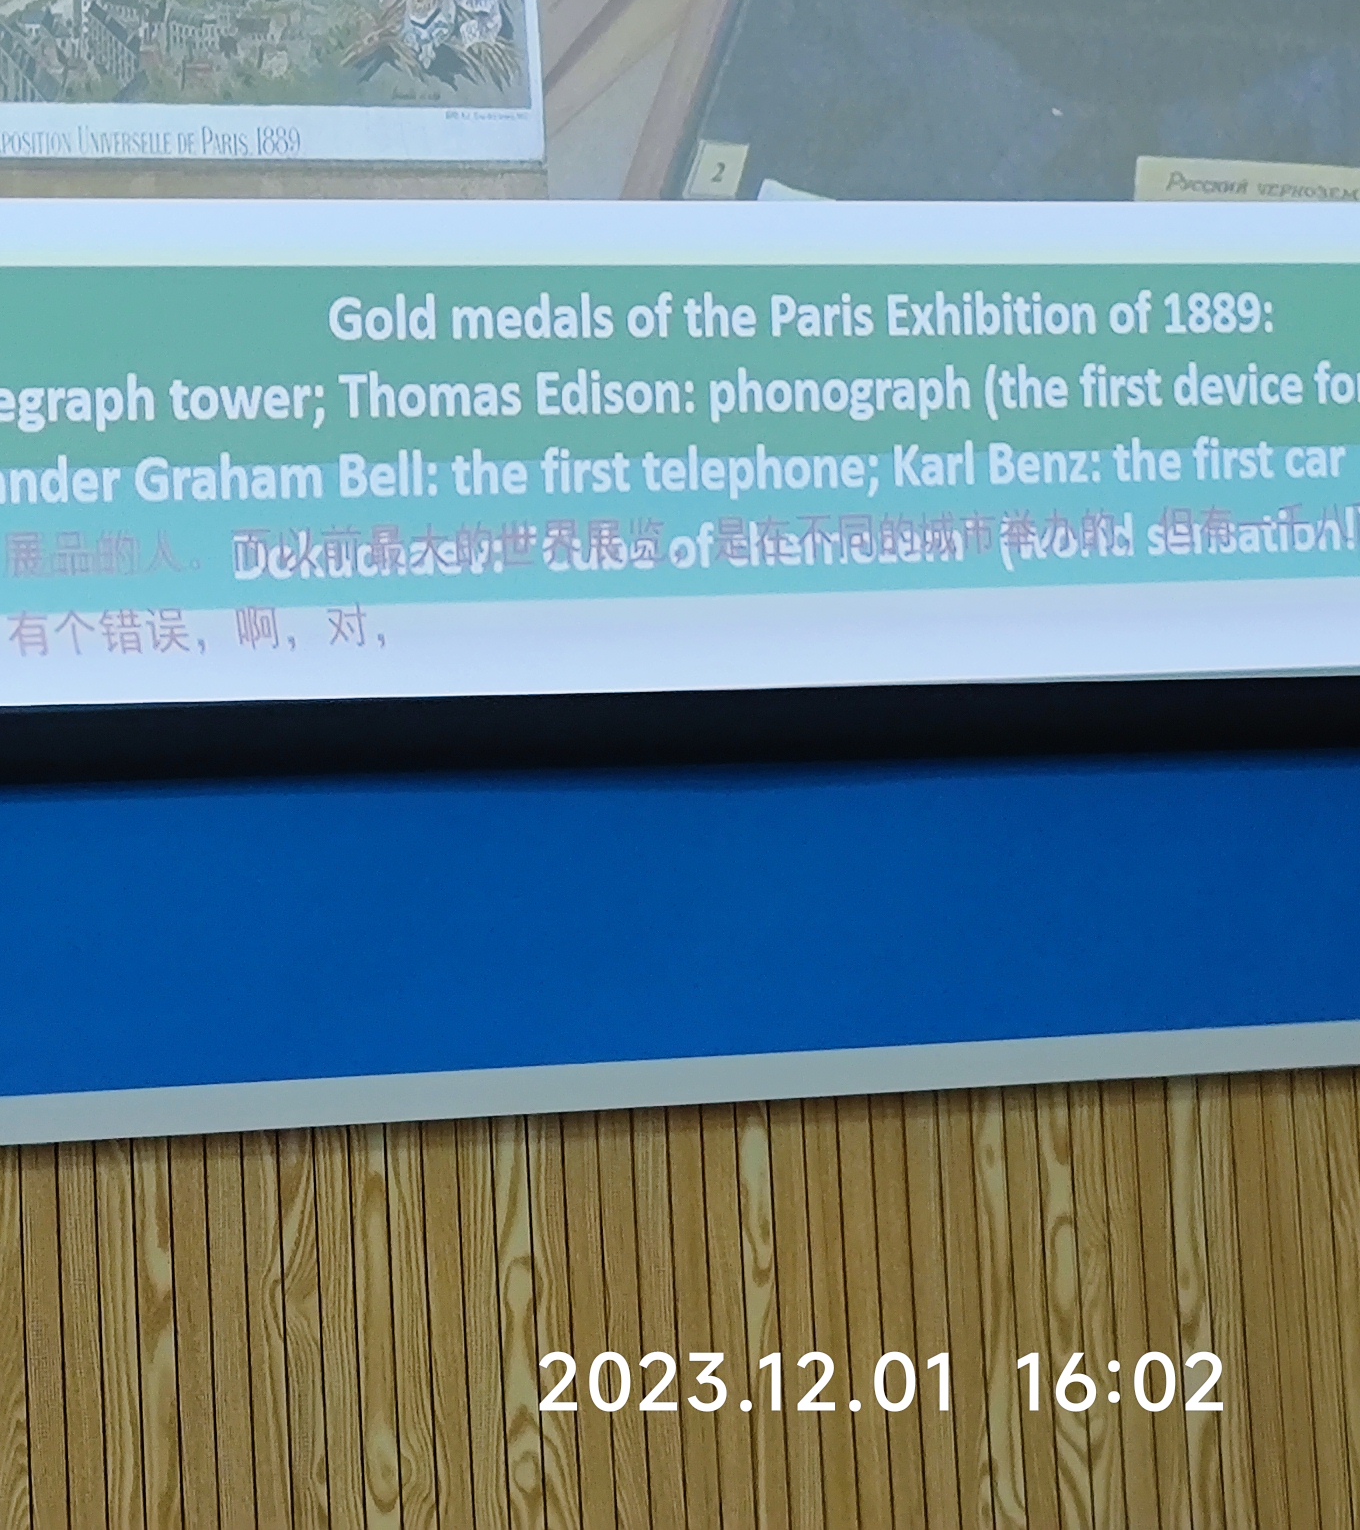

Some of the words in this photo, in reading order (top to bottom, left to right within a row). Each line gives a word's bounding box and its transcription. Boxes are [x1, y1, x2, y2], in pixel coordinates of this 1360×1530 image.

[256, 125, 302, 157] 1889
[710, 161, 726, 183] 2
[328, 294, 436, 342] Gold
[452, 293, 614, 340] medals
[627, 292, 672, 339] of
[684, 290, 757, 338] the
[770, 290, 874, 338] Paris
[886, 290, 1097, 337] Exhibition
[1108, 291, 1151, 335] of
[1164, 292, 1274, 334] 1889:
[170, 378, 326, 430] tower;
[339, 371, 522, 421] Thomas
[536, 369, 695, 418] Edison:
[709, 366, 970, 423] phonograph
[983, 364, 1068, 420] (the
[1080, 363, 1162, 410] first
[1174, 360, 1303, 407] device
[135, 454, 323, 503] Graham
[339, 451, 438, 500] Bell:
[452, 450, 528, 498] the
[542, 446, 630, 495] first
[643, 443, 879, 501] telephone;
[894, 441, 975, 489] Karl
[990, 440, 1101, 486] Benz:
[1114, 437, 1180, 484] the
[1193, 435, 1275, 481] first
[1285, 446, 1346, 479] car
[669, 521, 715, 569] of
[1148, 505, 1360, 556] sensation!
